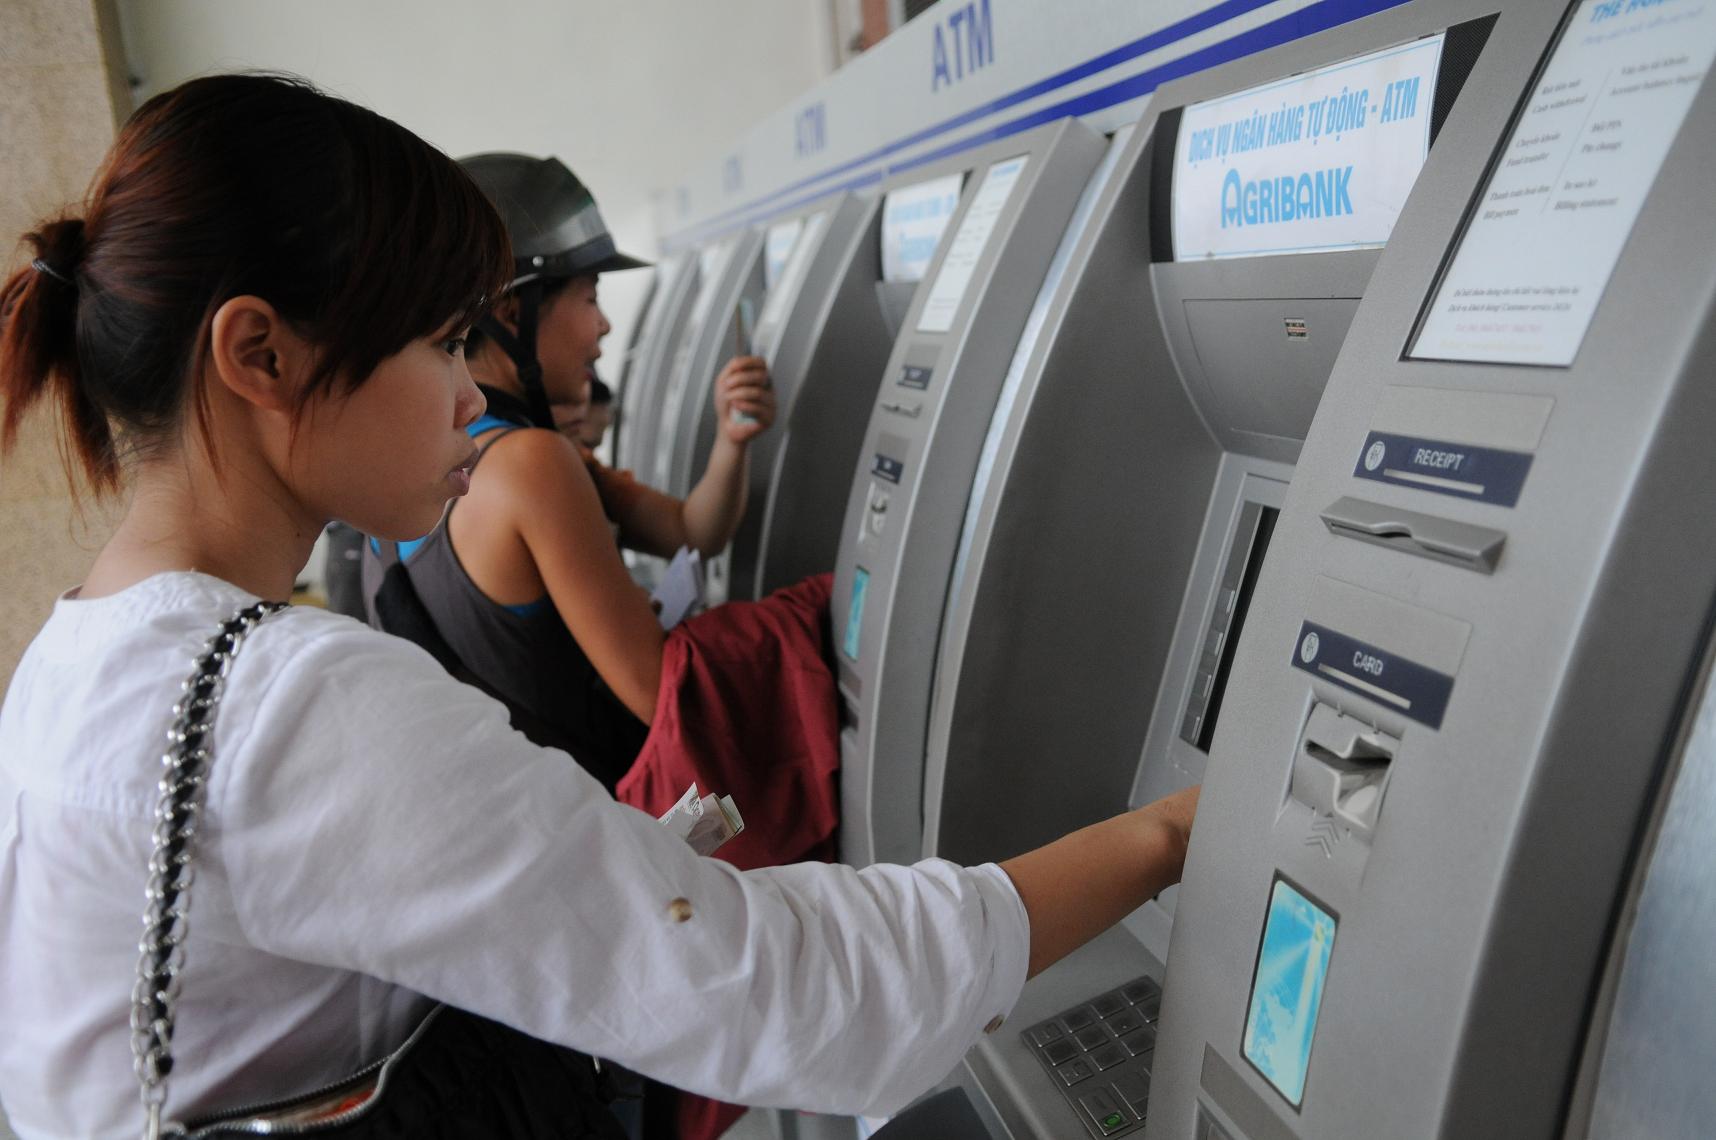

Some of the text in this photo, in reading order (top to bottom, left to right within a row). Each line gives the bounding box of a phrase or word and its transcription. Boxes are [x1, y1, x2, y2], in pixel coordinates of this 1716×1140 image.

[931, 0, 994, 92] ATM
[795, 102, 826, 158] ATM
[1188, 127, 1215, 167] DỊCH
[1215, 122, 1232, 164] VỤ
[1230, 109, 1268, 154] NGÂN
[1266, 102, 1305, 147] HÀNG
[1306, 95, 1330, 145] TỰ
[1325, 86, 1369, 142] ĐỘNG
[1379, 76, 1420, 124] ATM
[1221, 166, 1354, 229] AGRIBANK
[1414, 448, 1464, 470] RECEIPT
[1353, 651, 1384, 676] CARD
